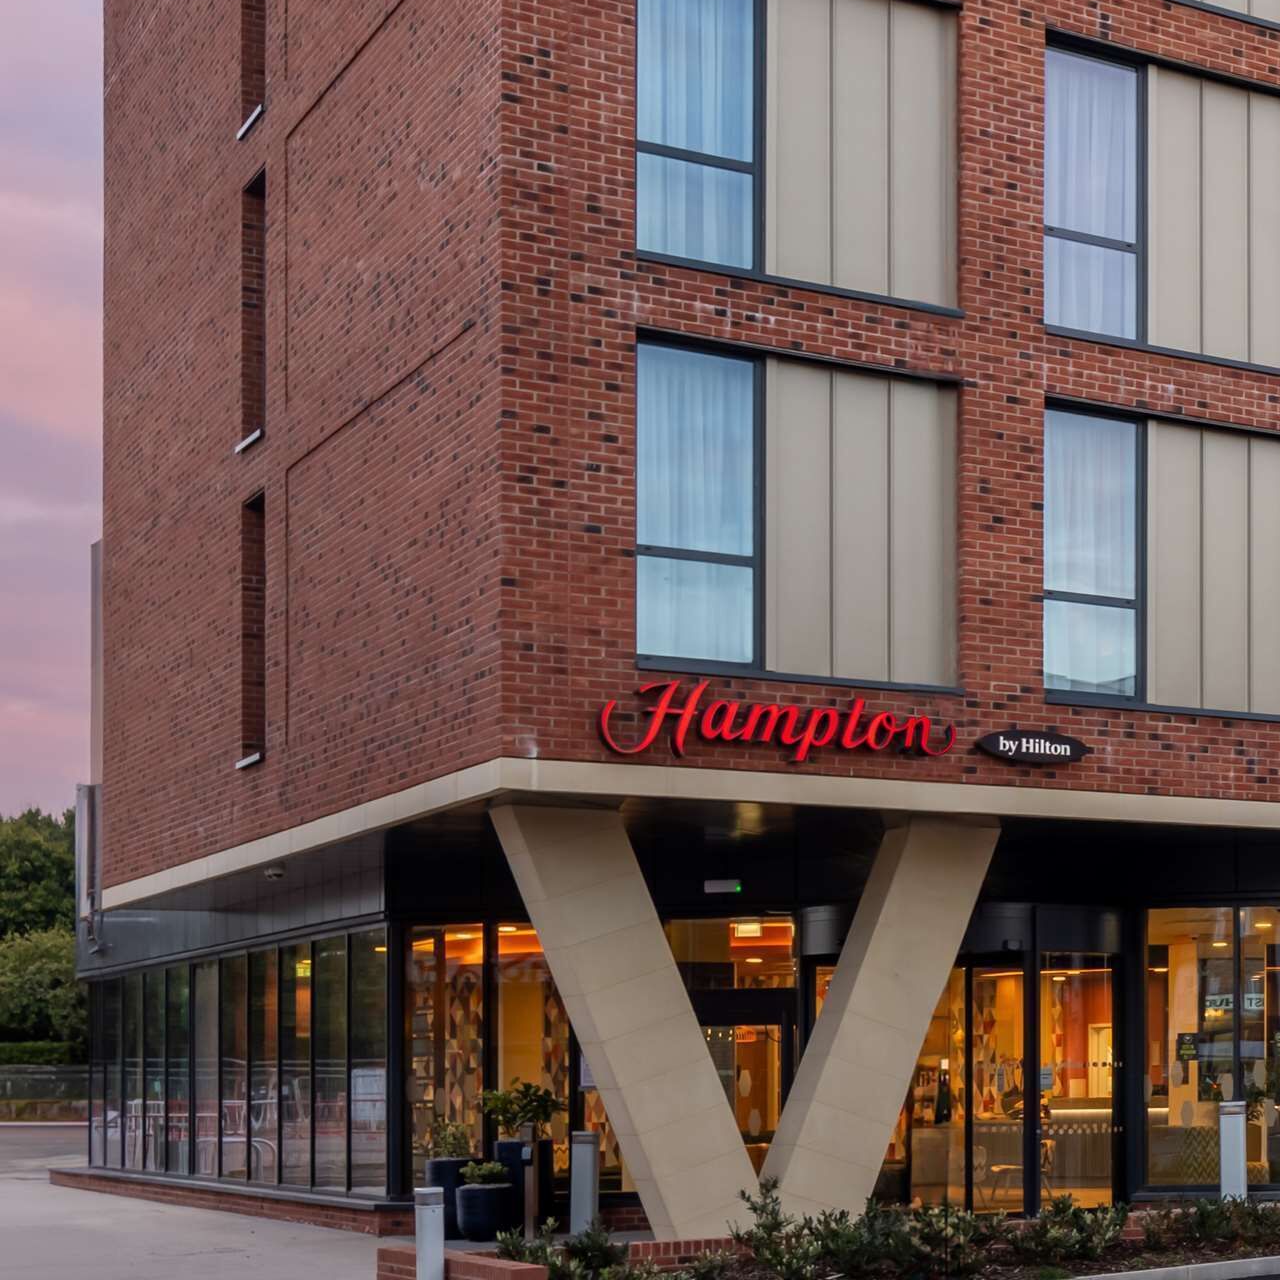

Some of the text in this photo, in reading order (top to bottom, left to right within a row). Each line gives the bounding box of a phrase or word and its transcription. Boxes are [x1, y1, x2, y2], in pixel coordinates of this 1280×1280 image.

[601, 679, 956, 762] Hampton
[999, 735, 1071, 756] by Hilton
